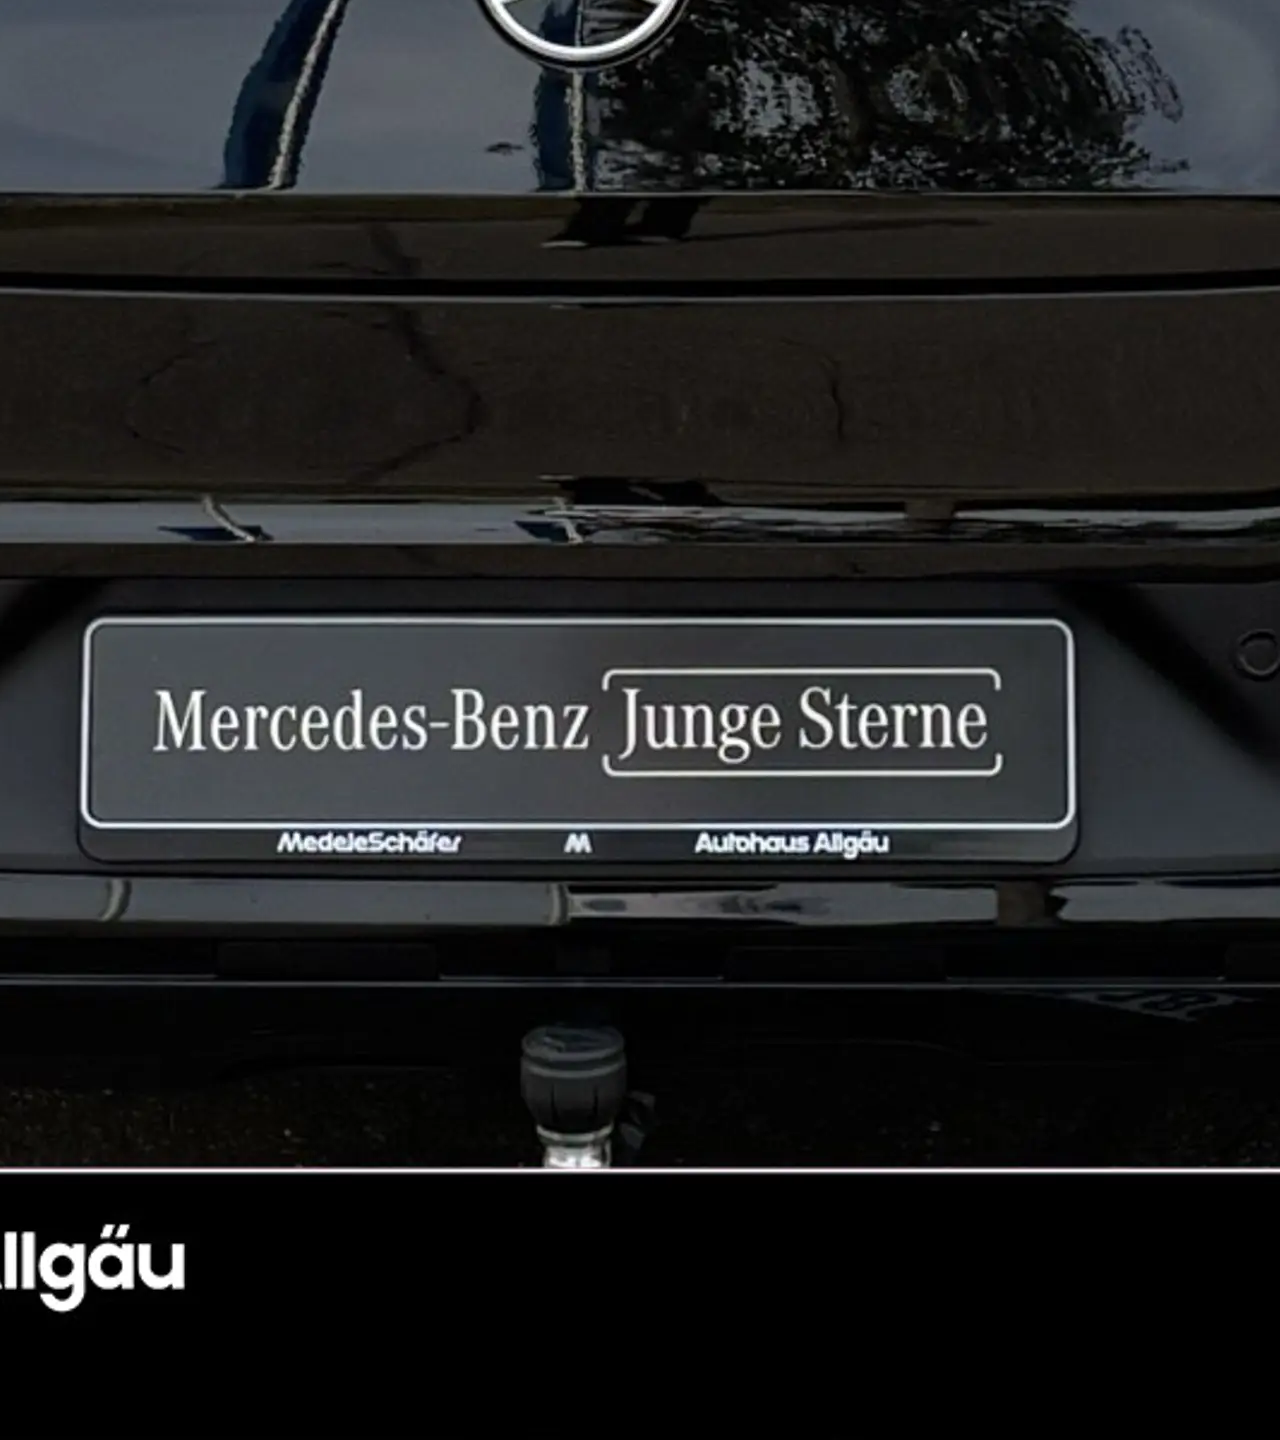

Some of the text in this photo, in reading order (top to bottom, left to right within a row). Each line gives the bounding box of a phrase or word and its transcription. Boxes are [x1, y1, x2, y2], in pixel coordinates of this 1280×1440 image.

[152, 685, 989, 765] Mercedes-Benz Junge Sterne
[276, 830, 463, 854] MedeleSchäfer
[694, 830, 890, 860] Autohaus Allgäu
